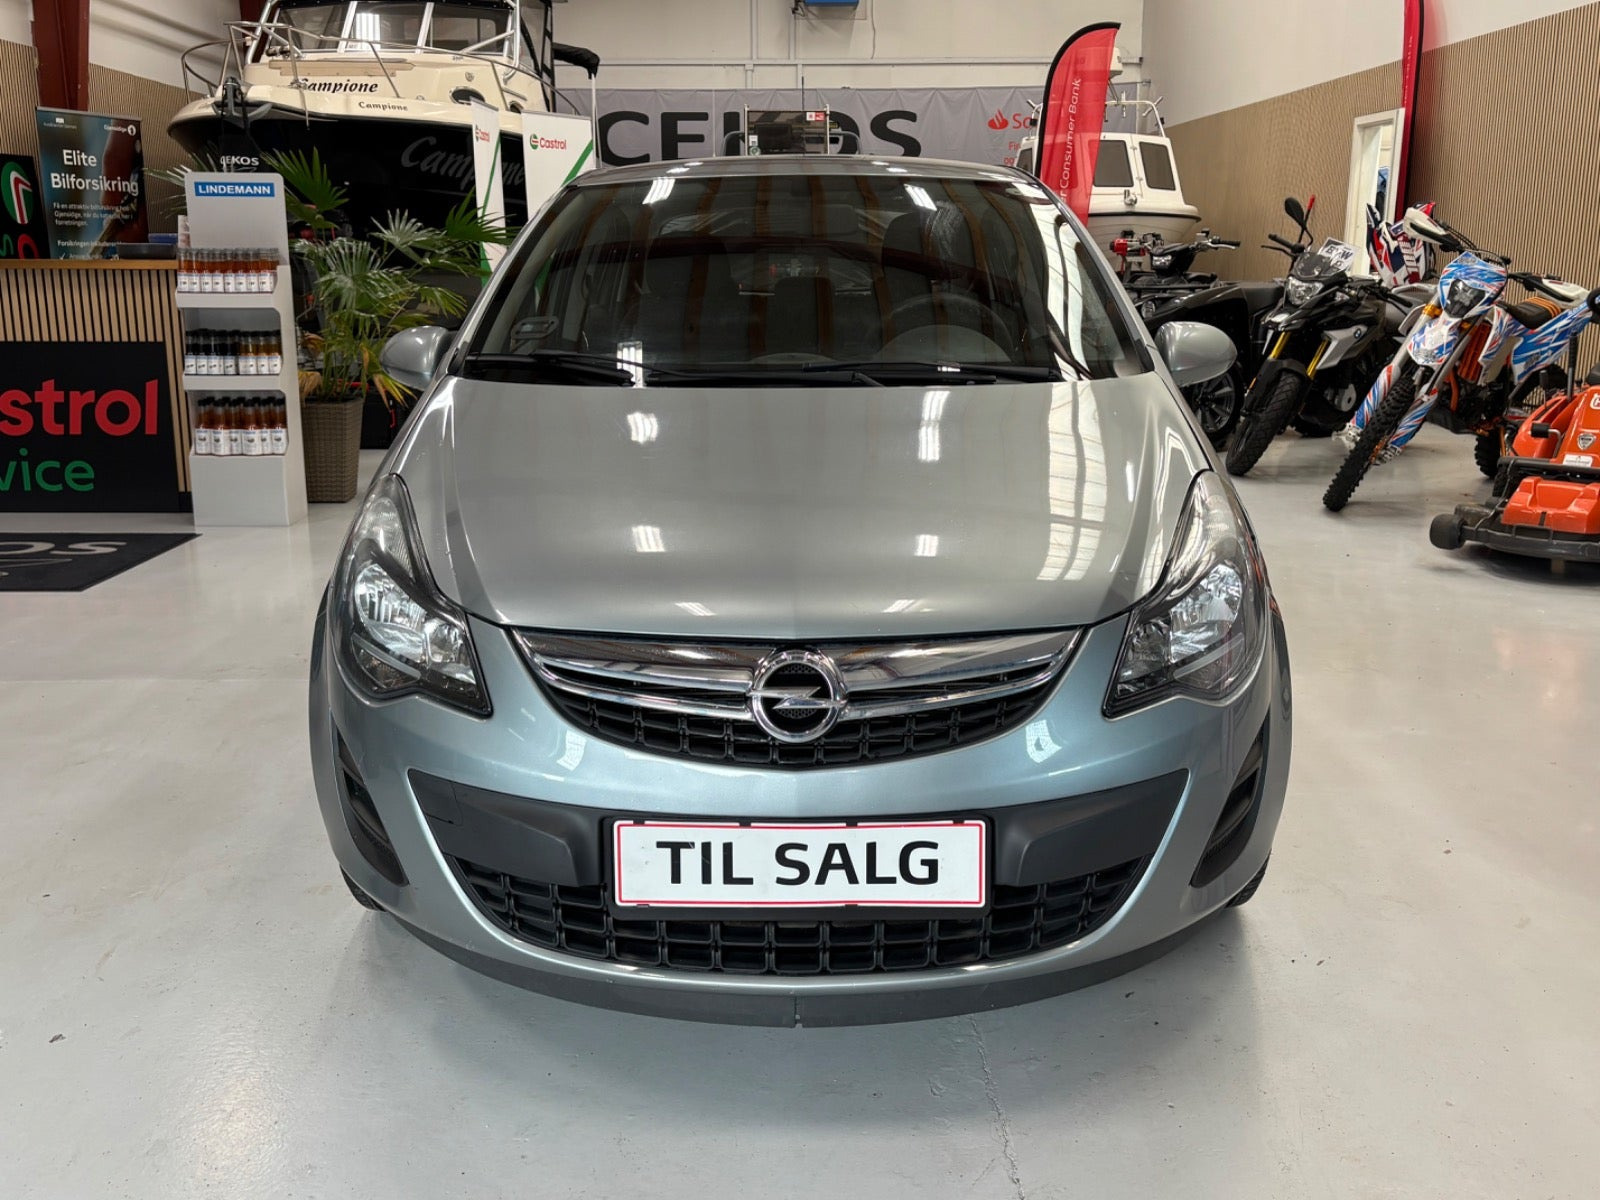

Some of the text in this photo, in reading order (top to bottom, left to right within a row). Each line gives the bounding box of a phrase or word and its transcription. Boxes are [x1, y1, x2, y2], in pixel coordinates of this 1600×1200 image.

[358, 101, 409, 111] Campione
[1060, 117, 1076, 189] Consumer
[1069, 79, 1081, 114] Bank
[539, 137, 567, 150] Castrol
[62, 149, 97, 167] Elite
[50, 172, 139, 197] Bilforsikring
[198, 184, 271, 195] LINDEMANN
[1326, 245, 1353, 260] BW
[656, 841, 939, 886] TIL SALG
